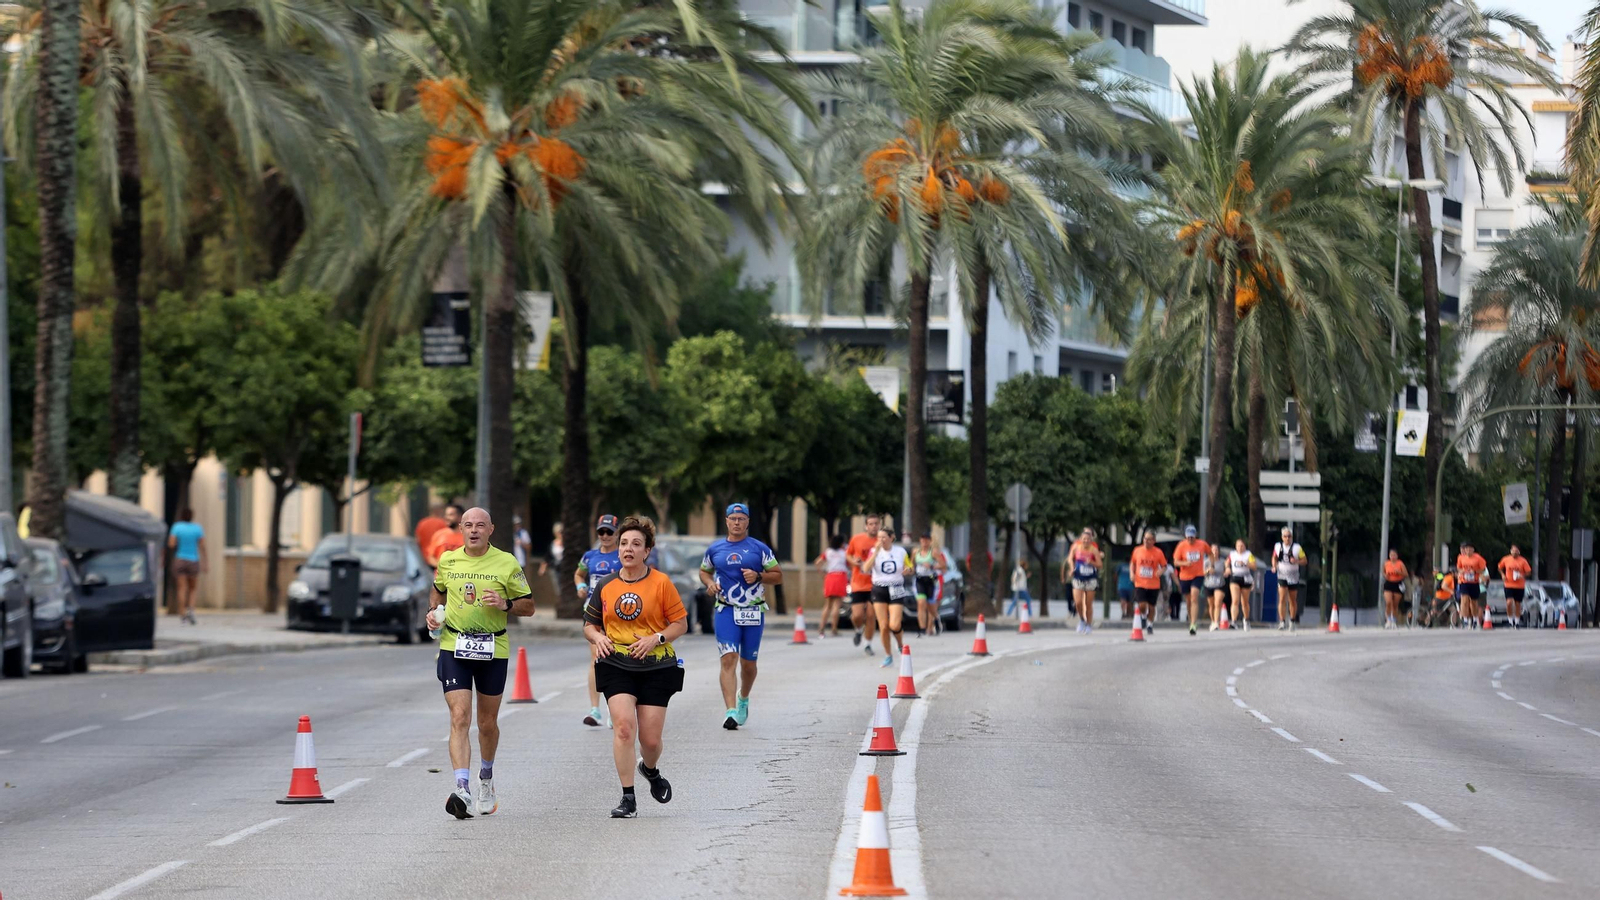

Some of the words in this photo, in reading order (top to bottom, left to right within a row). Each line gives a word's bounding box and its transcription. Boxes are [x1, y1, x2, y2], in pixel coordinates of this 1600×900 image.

[447, 571, 498, 581] Paparunners
[616, 608, 641, 620] RUNNERS
[740, 611, 755, 619] 846
[465, 641, 485, 651] 626
